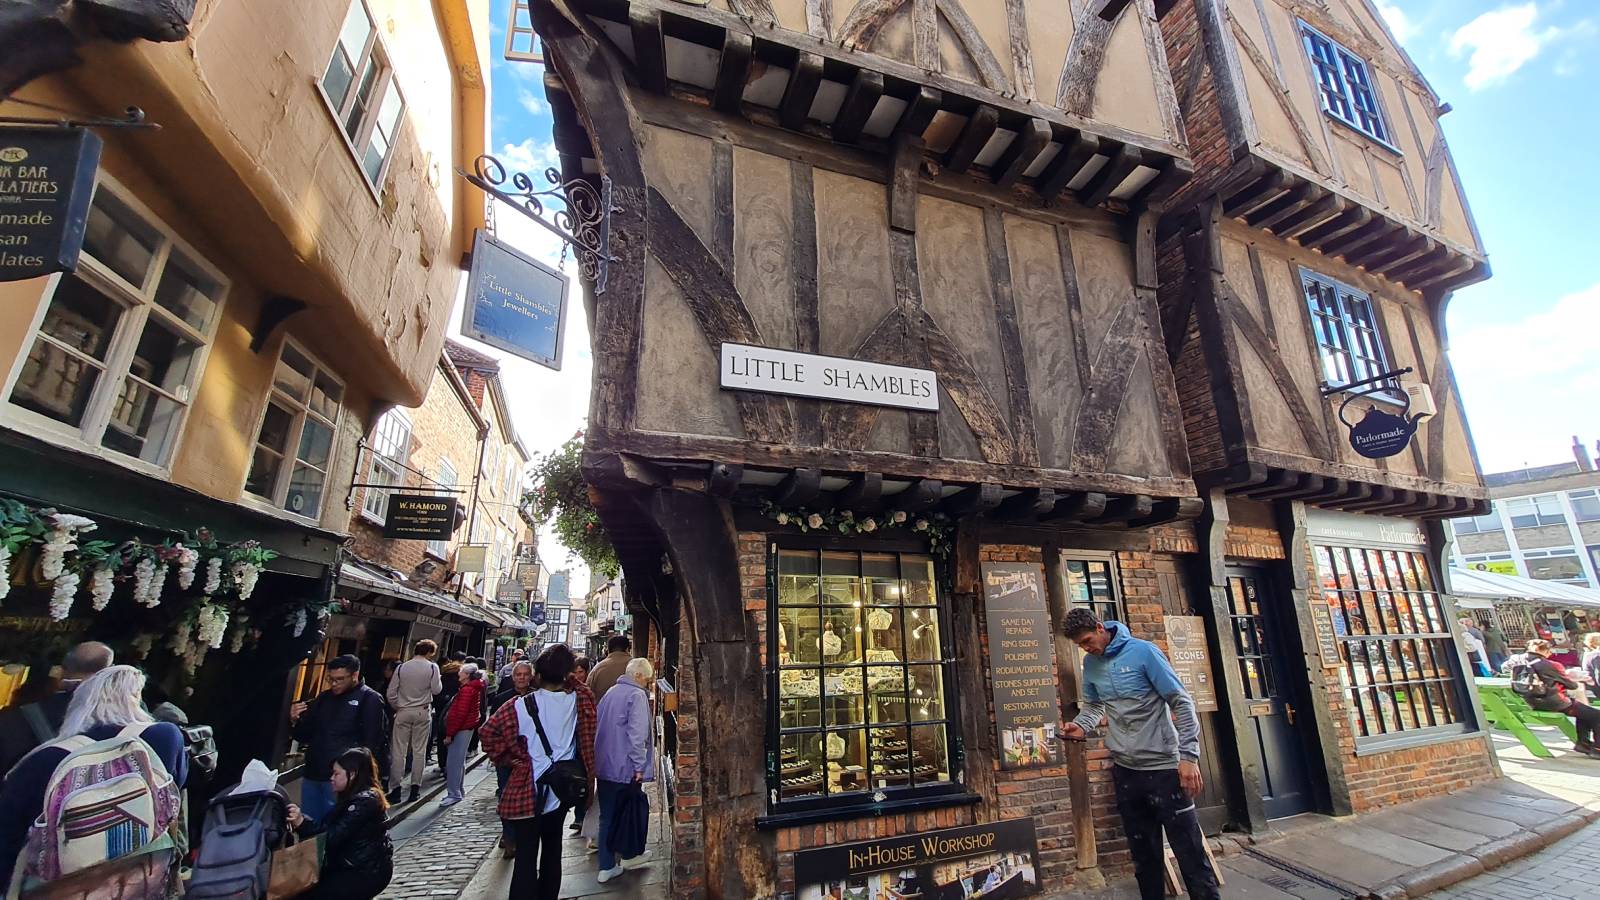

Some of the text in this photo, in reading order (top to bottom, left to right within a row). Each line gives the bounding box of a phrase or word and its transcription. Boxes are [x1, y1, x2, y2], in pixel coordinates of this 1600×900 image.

[18, 166, 48, 179] BAR
[0, 181, 58, 194] LATIERS
[0, 210, 53, 225] made
[1, 252, 44, 266] lates
[489, 280, 552, 315] Little Shambles
[502, 299, 538, 320] Jewellers
[730, 356, 931, 398] LITTLE SHAMBLES
[1355, 427, 1405, 445] Parlormade
[409, 502, 447, 511] HAMOND
[1378, 523, 1426, 544] Parlormade
[1001, 618, 1035, 626] SAME DAY
[1005, 627, 1032, 635] REPAIRS
[1001, 639, 1039, 648] RING SIZING
[1004, 652, 1038, 661] POLISHING
[1174, 650, 1205, 660] SCONES
[995, 677, 1053, 689] STONES SUPPLIED
[1011, 687, 1040, 697] AND SET
[1003, 701, 1050, 711] RESTORATION
[1013, 715, 1043, 724] BESPOKE
